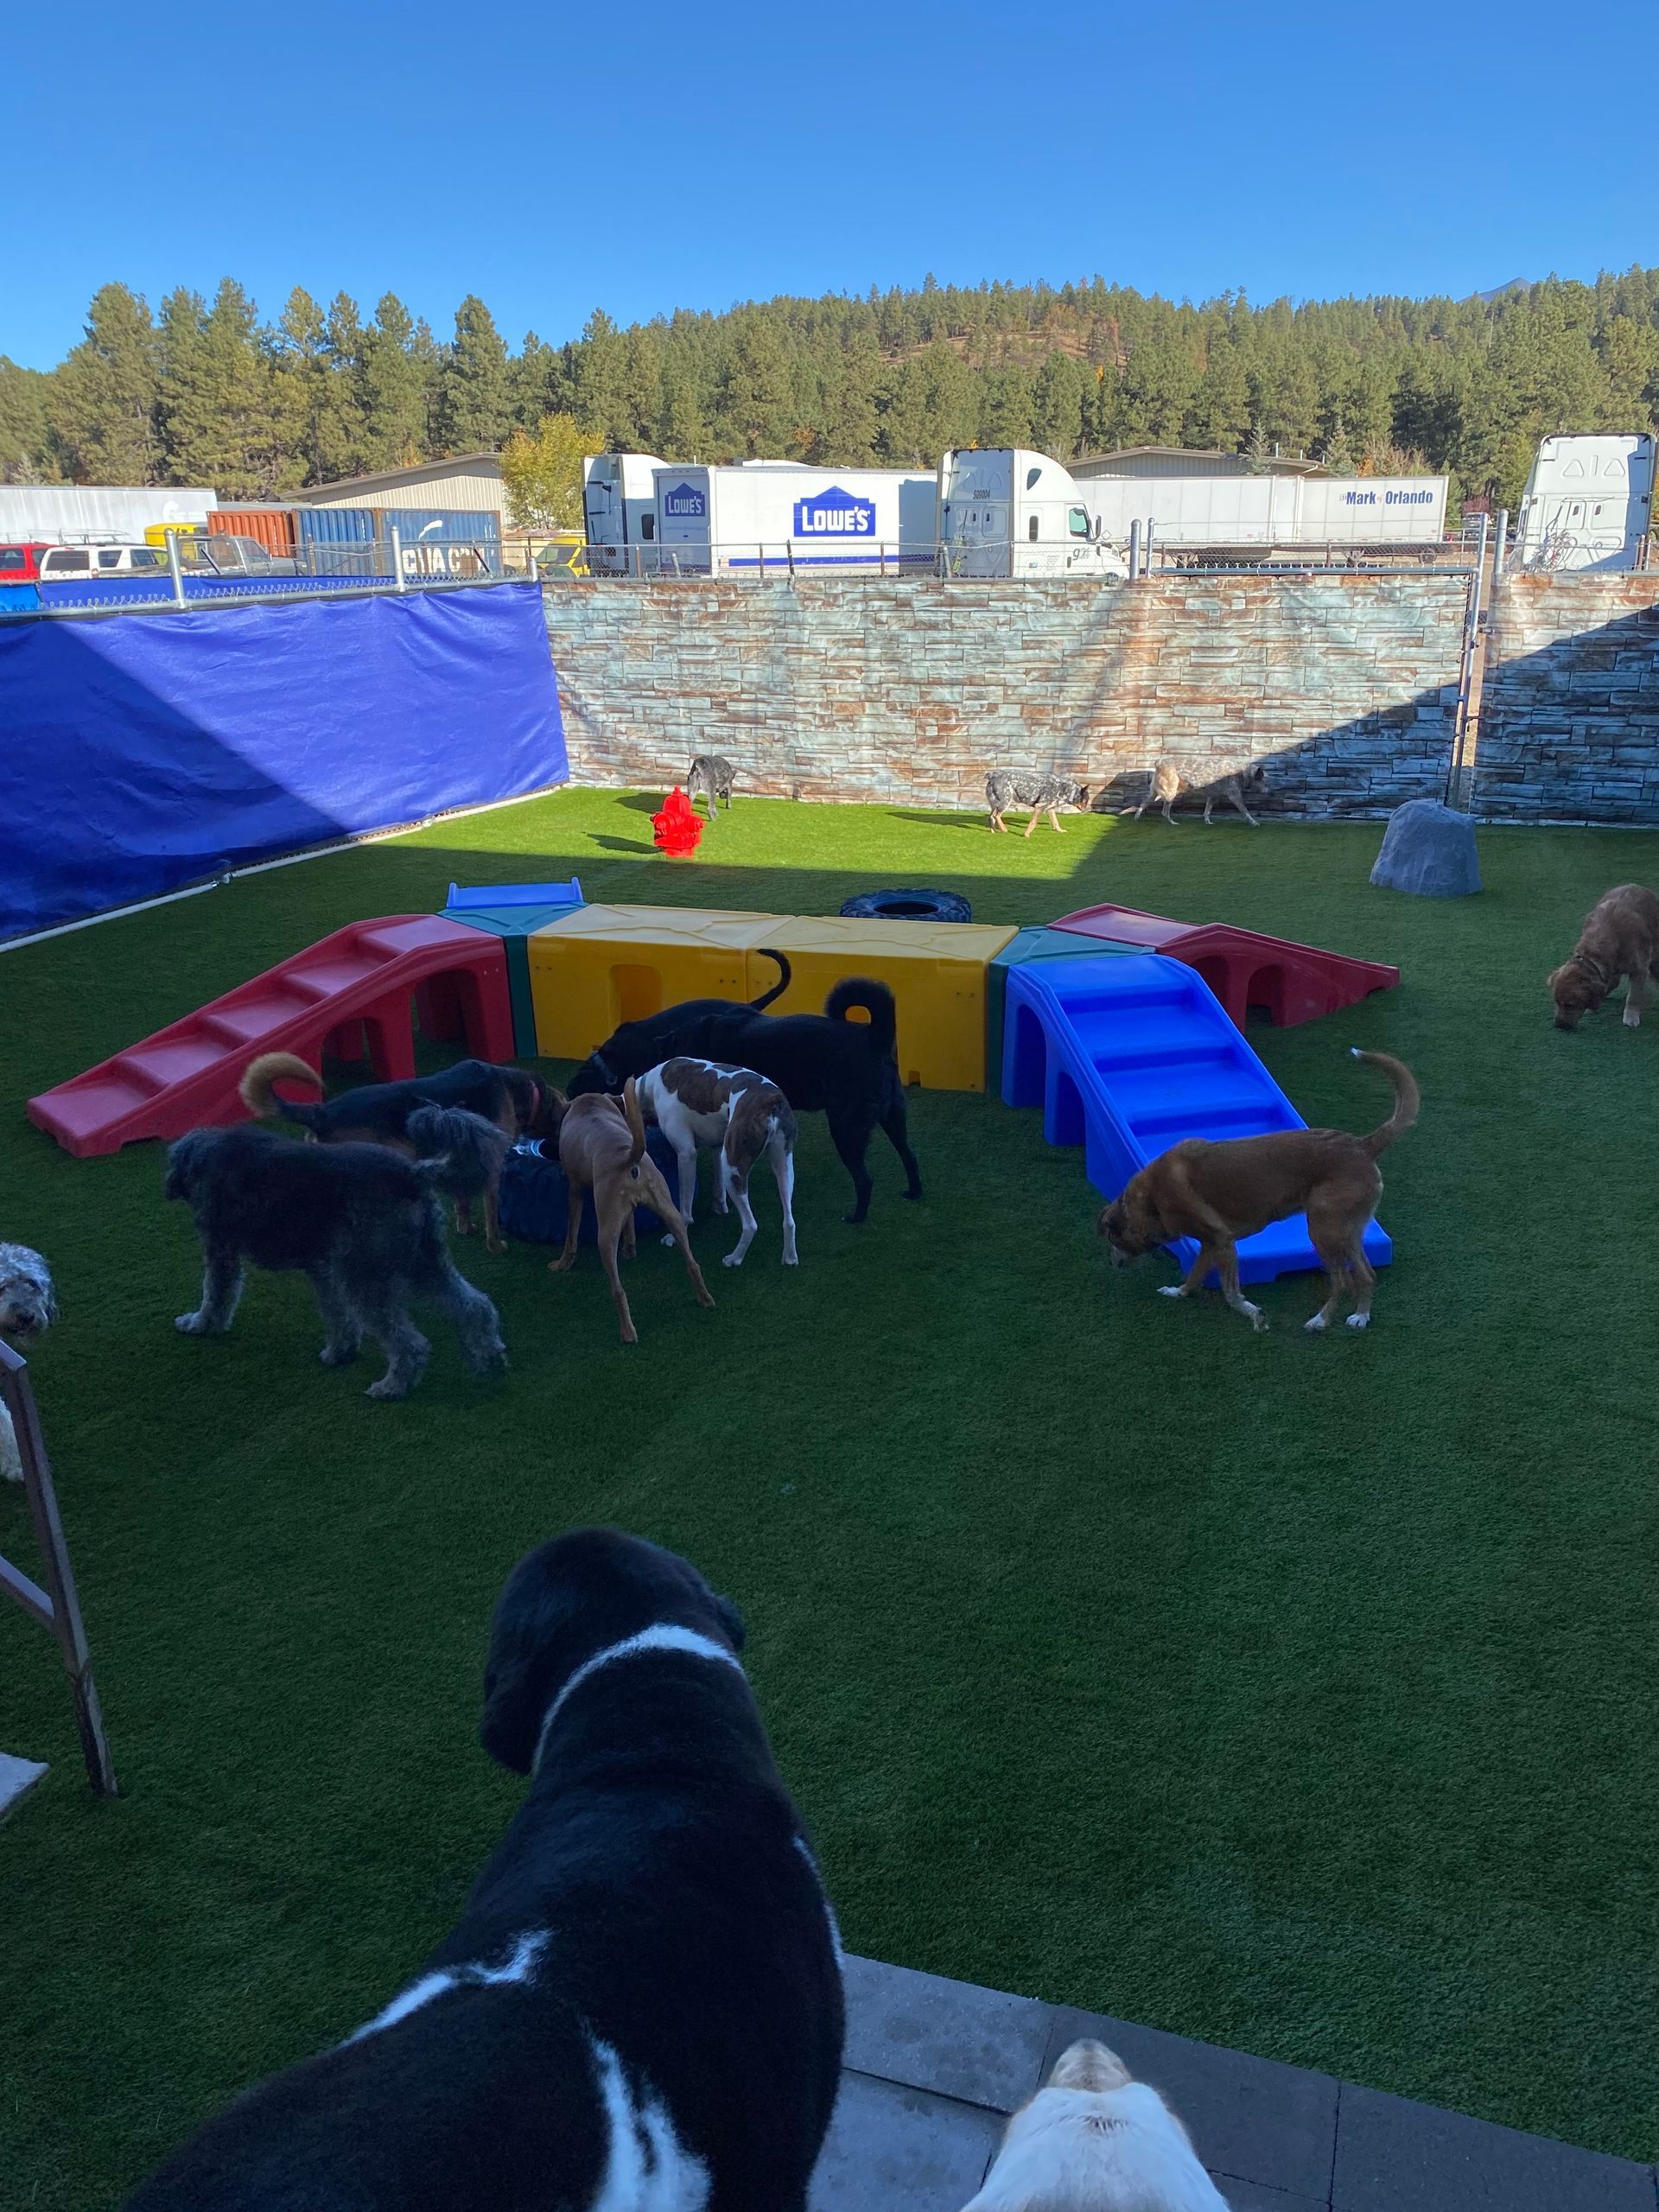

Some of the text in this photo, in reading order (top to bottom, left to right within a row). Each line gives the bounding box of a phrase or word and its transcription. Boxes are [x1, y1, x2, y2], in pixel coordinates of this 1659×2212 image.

[668, 495, 702, 514] LOWE'S
[1345, 491, 1376, 505] Mark
[1385, 490, 1433, 505] Orlando
[801, 505, 869, 531] LOWE'S
